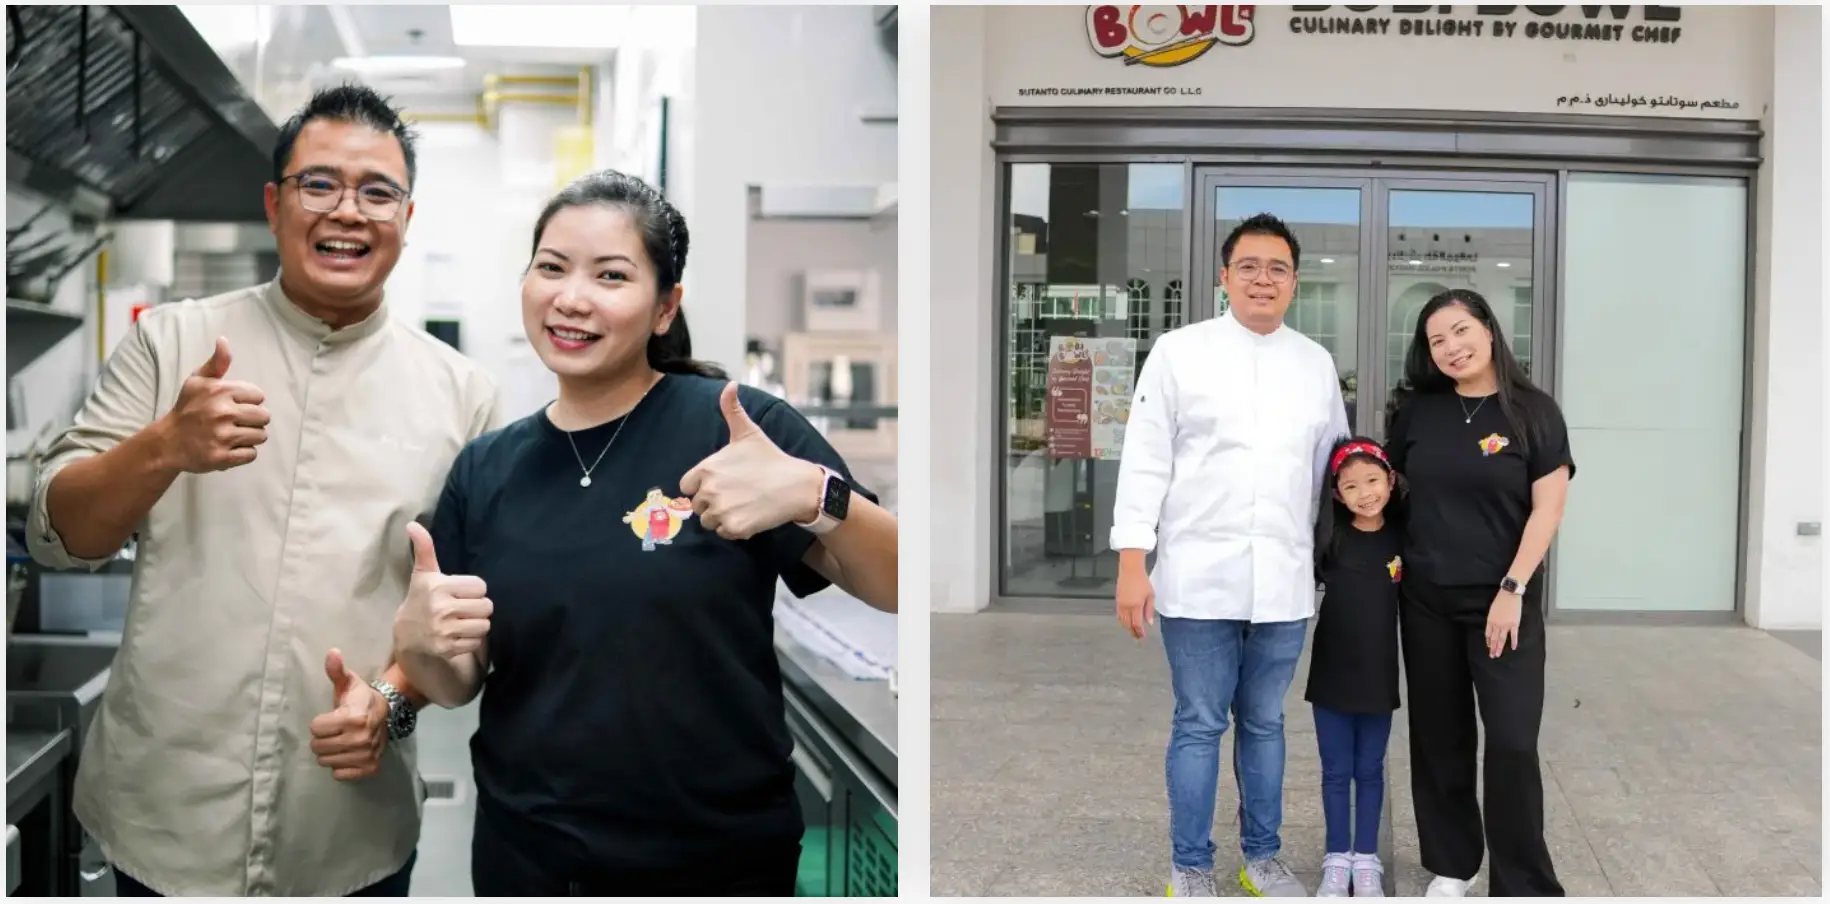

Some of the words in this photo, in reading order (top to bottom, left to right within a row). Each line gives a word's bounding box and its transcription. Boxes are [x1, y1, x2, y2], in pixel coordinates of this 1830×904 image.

[1290, 17, 1390, 34] CULINARY
[1400, 19, 1484, 36] DELIGHT
[1493, 21, 1517, 37] BY
[1525, 22, 1623, 41] GOURMET
[1631, 26, 1681, 43] CHEF
[1018, 88, 1058, 96] SUTANTO
[1060, 87, 1102, 95] CULINARY
[1104, 87, 1161, 95] RESTAURANT
[1700, 98, 1740, 111] مطعم
